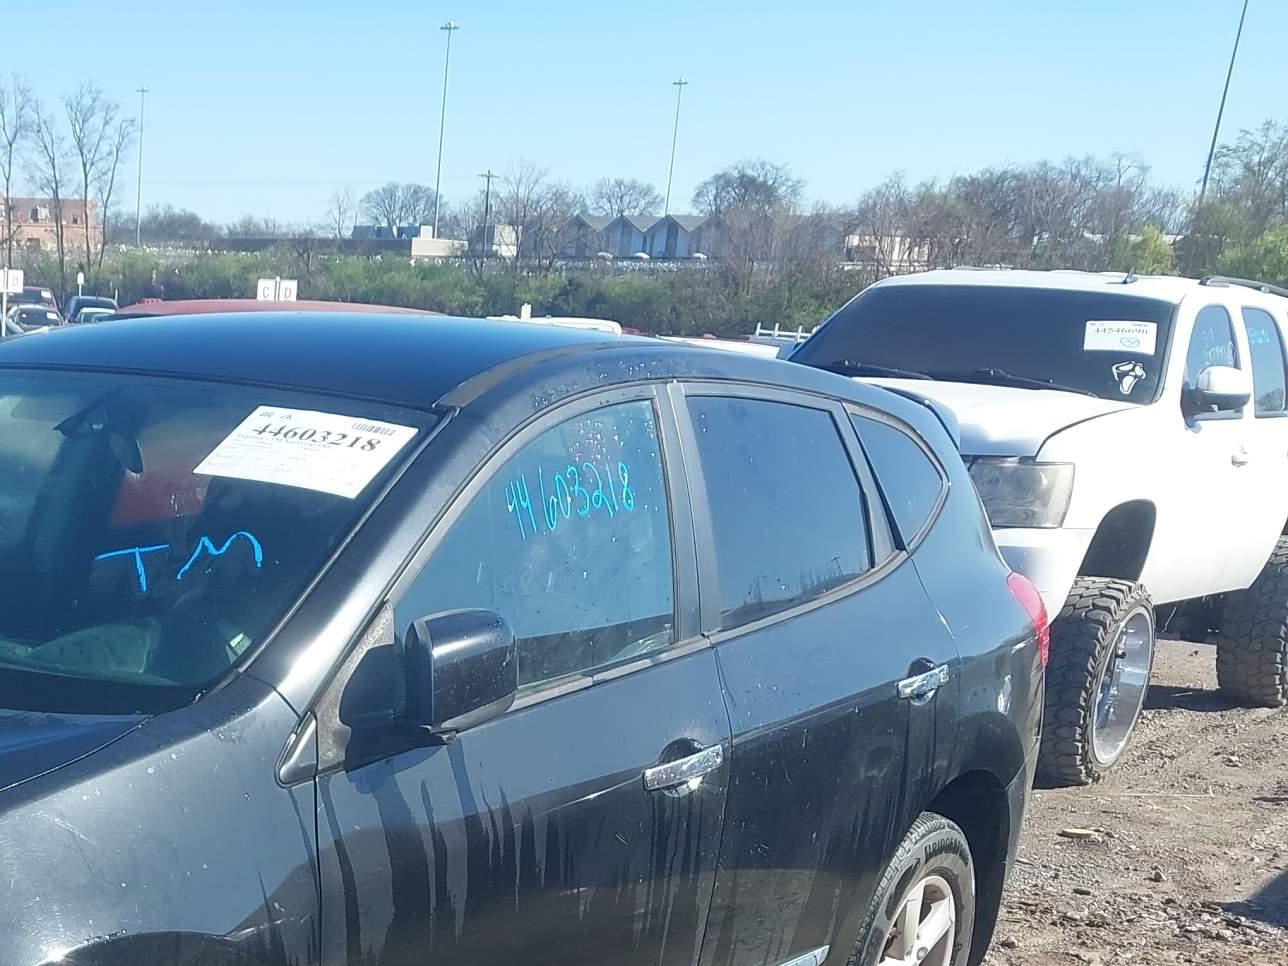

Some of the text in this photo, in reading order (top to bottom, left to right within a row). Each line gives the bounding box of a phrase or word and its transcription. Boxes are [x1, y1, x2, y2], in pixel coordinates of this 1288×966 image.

[262, 286, 270, 299] C
[284, 286, 292, 299] D
[253, 423, 381, 452] 44603218
[505, 462, 634, 540] 44603218
